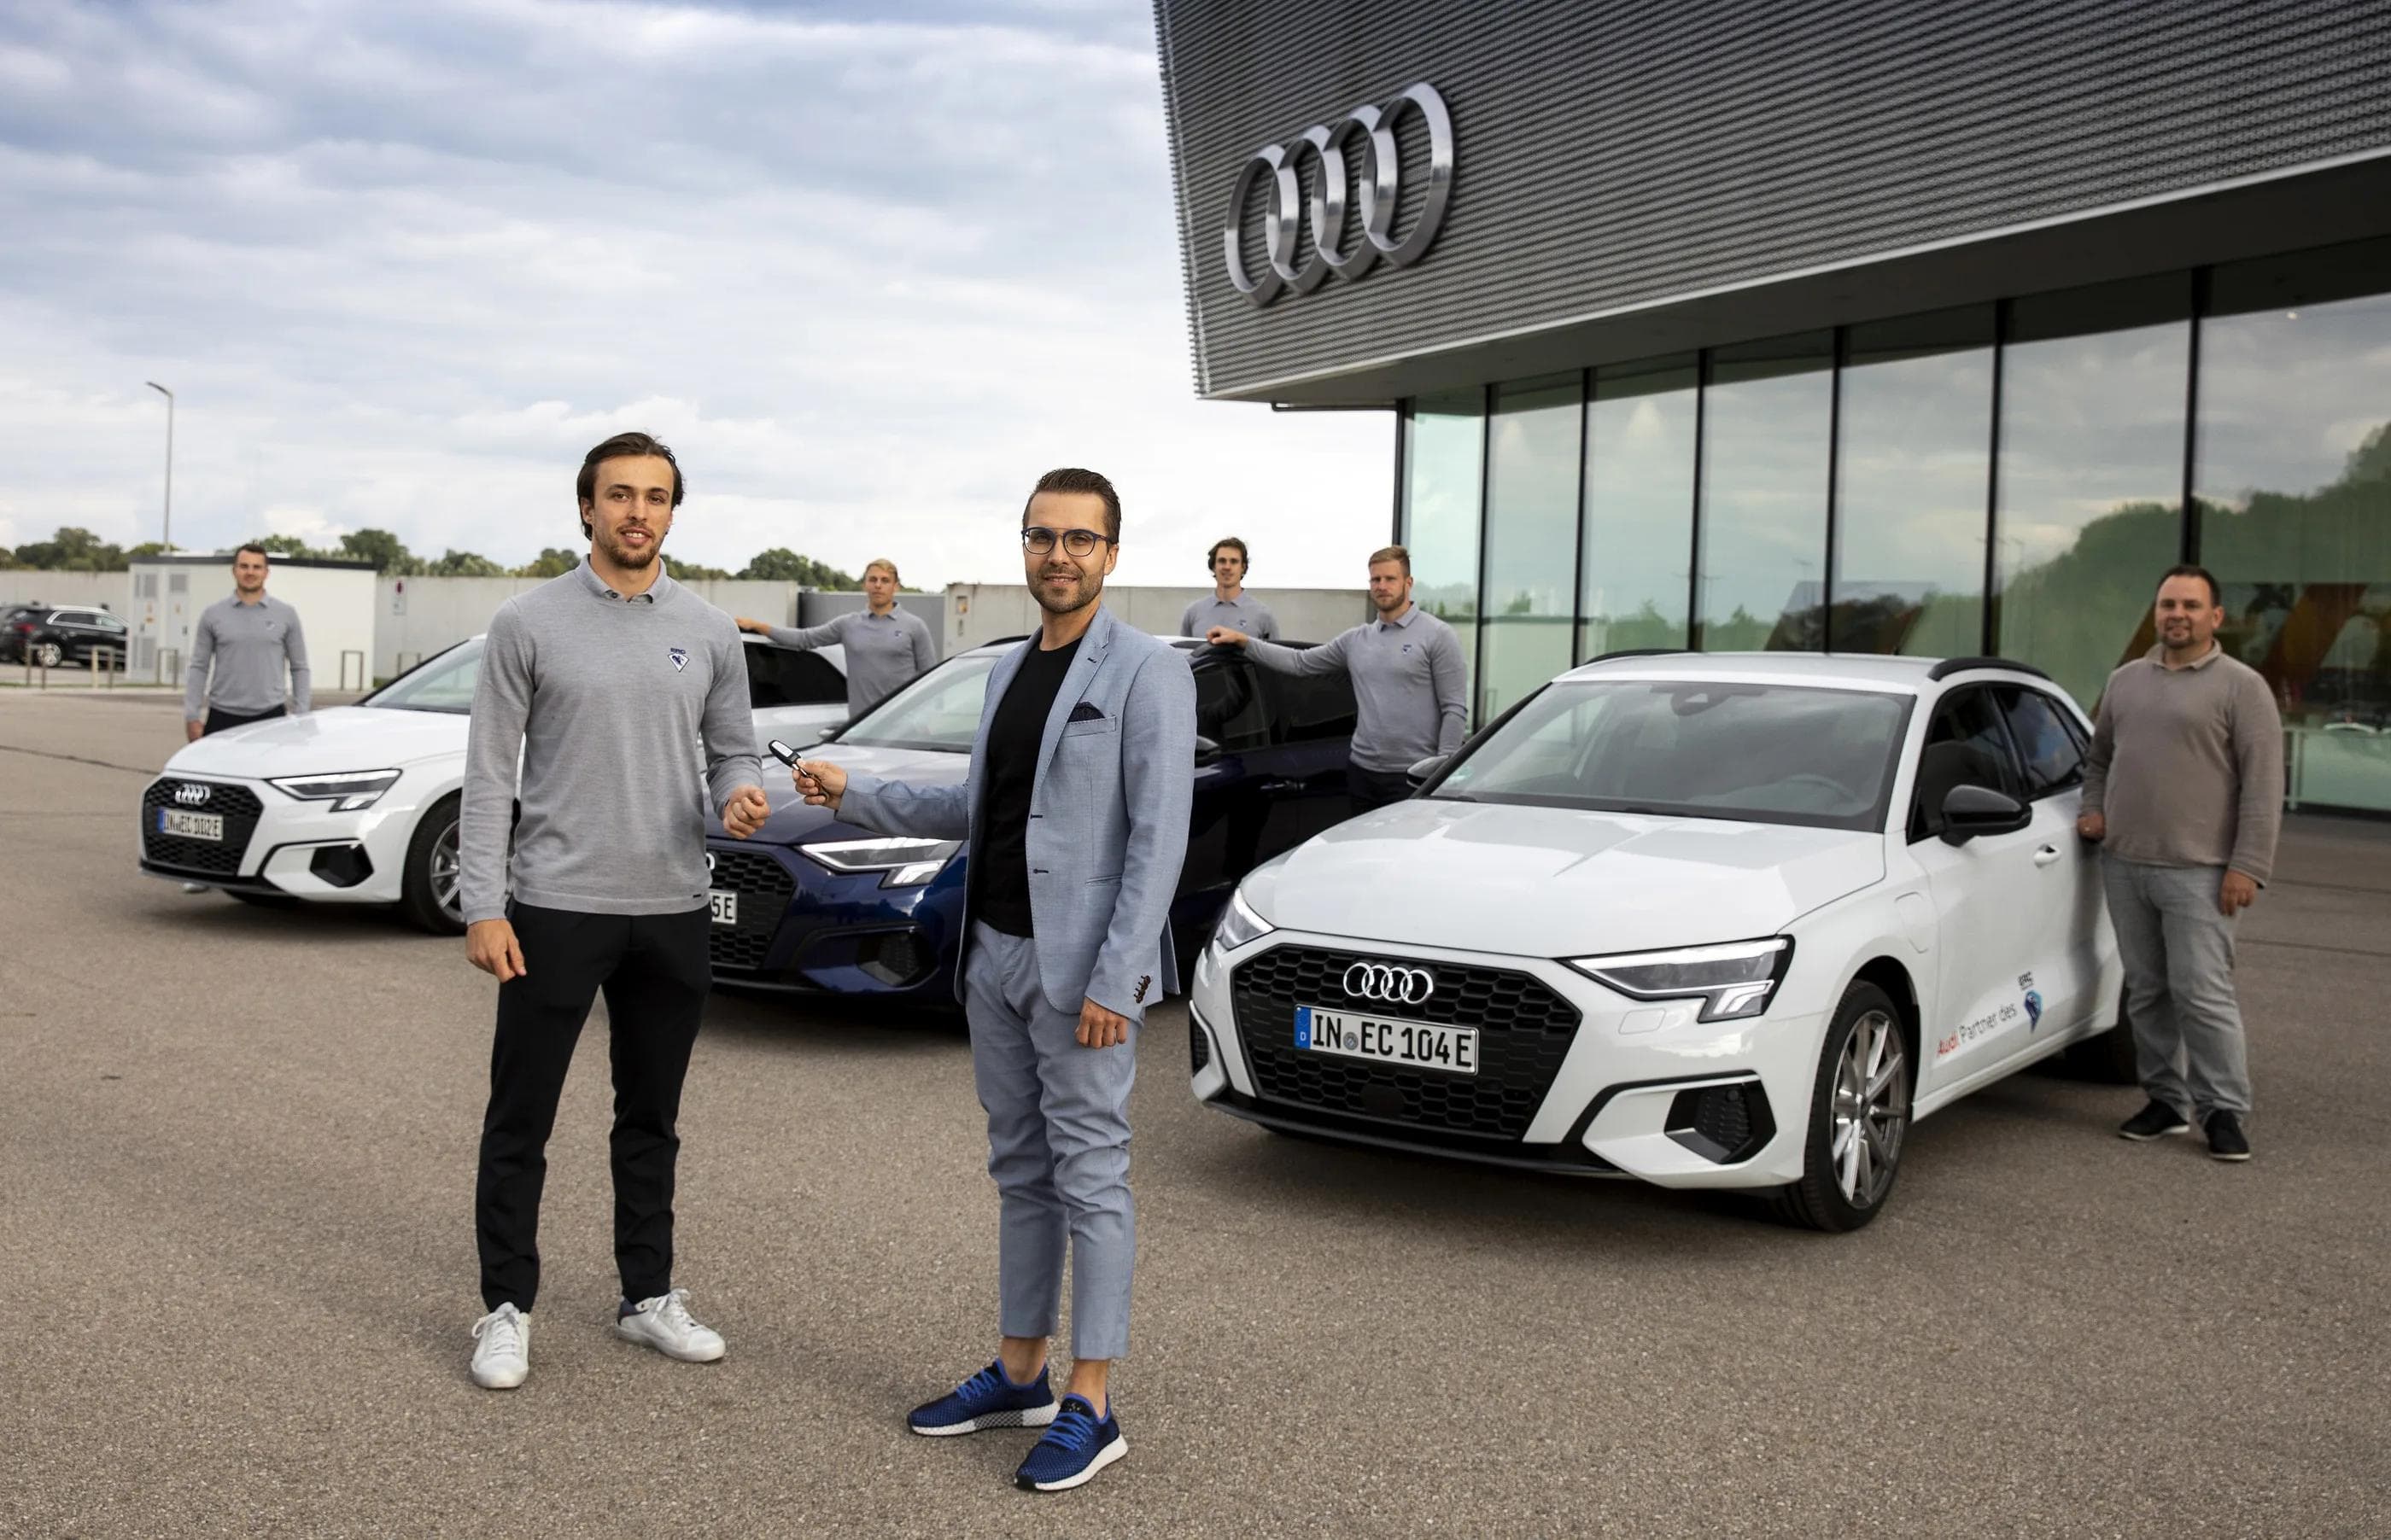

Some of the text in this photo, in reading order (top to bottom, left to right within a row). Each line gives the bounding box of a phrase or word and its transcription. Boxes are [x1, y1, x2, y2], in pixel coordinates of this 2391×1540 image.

[1312, 1014, 1342, 1049] IN
[1360, 1021, 1394, 1057] EC
[1937, 1004, 2018, 1058] Audi Partner des
